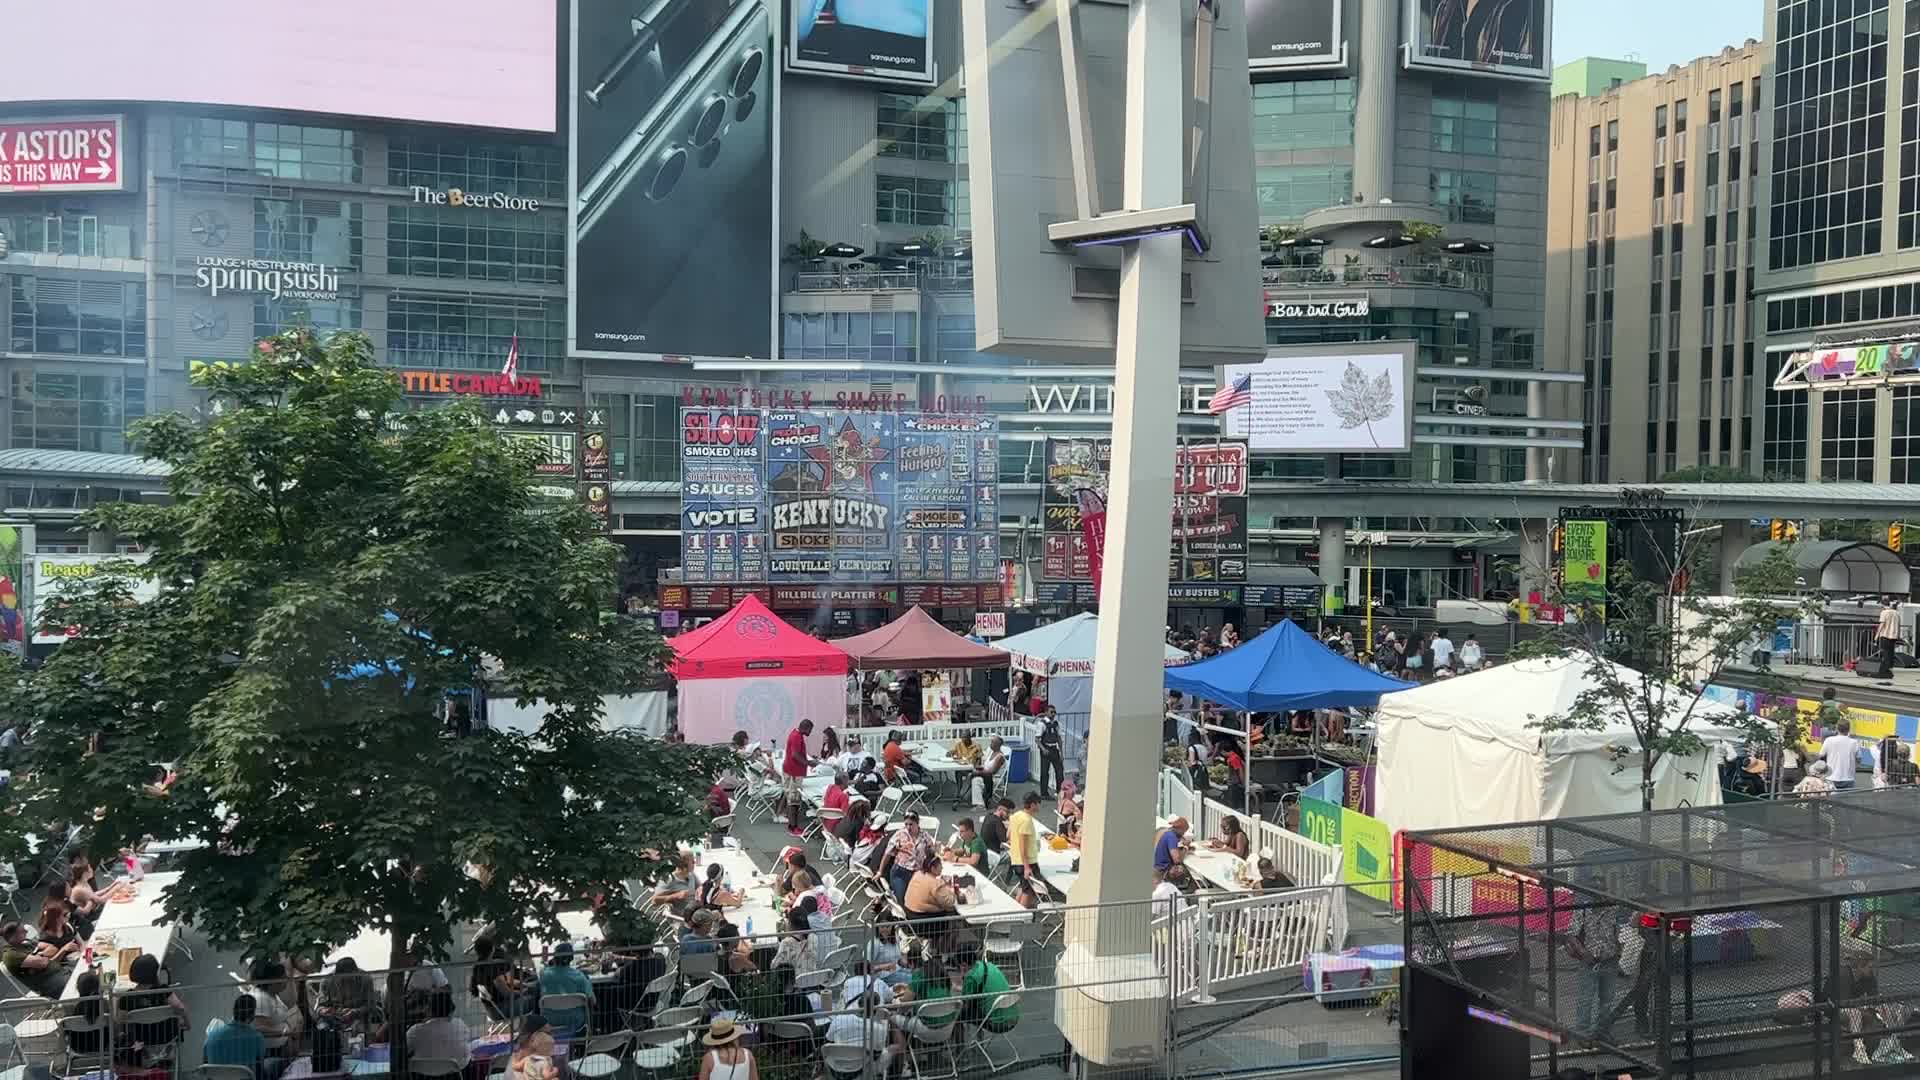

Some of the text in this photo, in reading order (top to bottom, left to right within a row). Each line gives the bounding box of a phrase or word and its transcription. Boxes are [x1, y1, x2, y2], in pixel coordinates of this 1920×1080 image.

[1271, 41, 1322, 51] samsung.com
[870, 54, 916, 65] samsung.com
[1491, 49, 1533, 61] samsung.com
[14, 129, 112, 161] ASTOR'S
[15, 162, 46, 182] THIS
[49, 161, 82, 181] WAY
[409, 185, 539, 212] The Beer Store
[196, 255, 318, 273] LOUNGE RESTAURANT
[1274, 301, 1369, 318] Bar and Grill
[593, 332, 646, 342] samsung.com
[1856, 347, 1878, 372] 20
[400, 371, 449, 392] TTLE
[682, 384, 813, 411] KENTUCKY
[835, 391, 907, 413] SMOKE
[1456, 403, 1489, 416] CINEP
[684, 413, 760, 446] SLOW
[916, 423, 981, 431] CHICKEN
[771, 433, 820, 447] CHOICE
[685, 447, 731, 457] SMOKED
[688, 508, 756, 527] VOTE
[773, 499, 889, 530] KENTUCKY
[1566, 523, 1595, 536] EVENTS
[781, 534, 883, 546] SMOKE HOUSE
[1566, 536, 1593, 548] AT THE
[1567, 549, 1595, 561] SQUARE
[41, 560, 98, 577] Roaste
[771, 560, 832, 572] LOUISVILLE
[838, 559, 892, 572] KENTUCKY
[777, 591, 828, 599] HILLBILLY
[831, 591, 876, 600] PLATTER
[1185, 588, 1220, 598] BUSTER
[975, 615, 1005, 630] HENNA
[1059, 662, 1093, 673] HENNA
